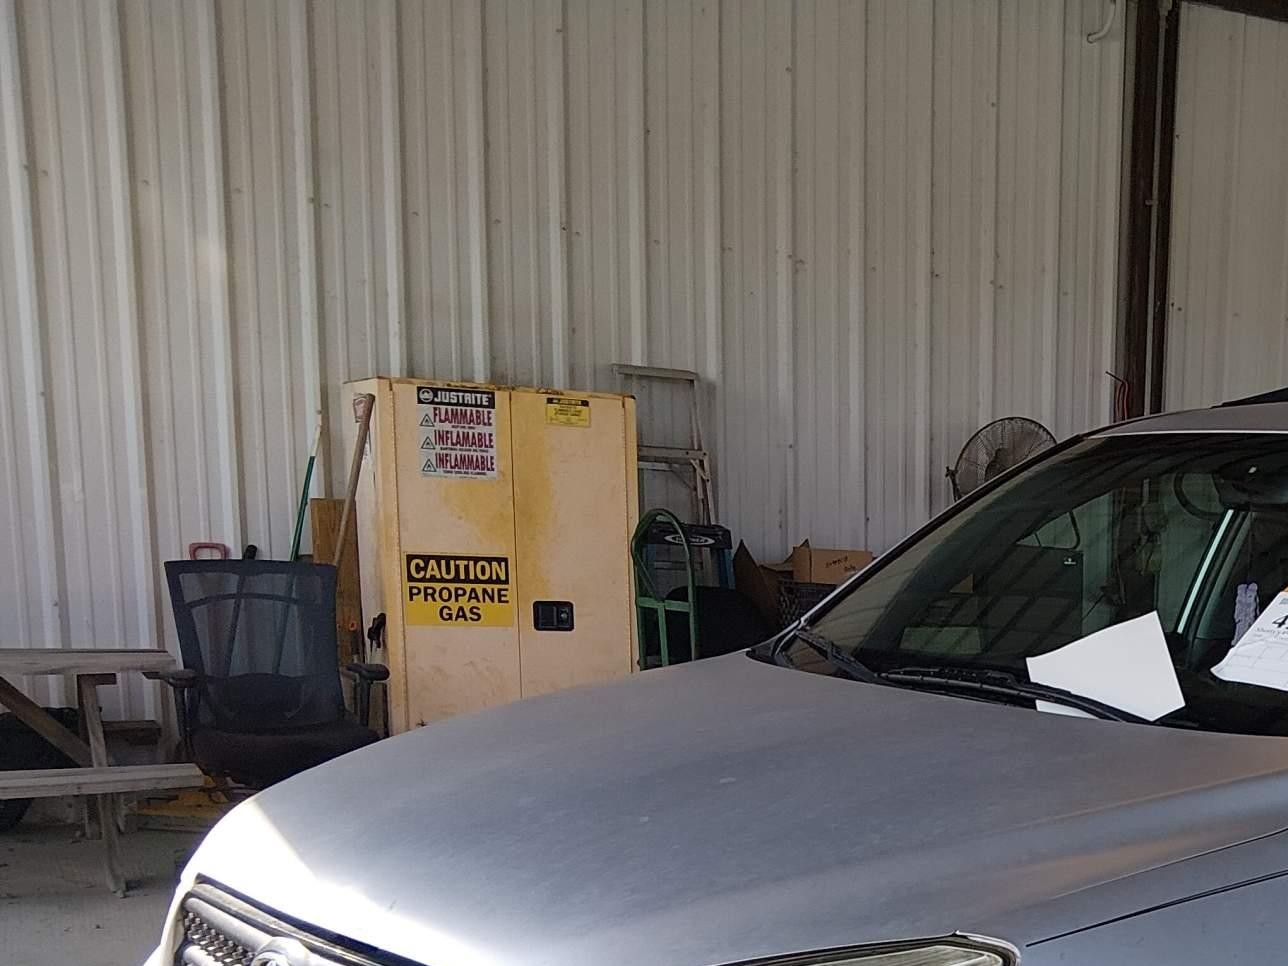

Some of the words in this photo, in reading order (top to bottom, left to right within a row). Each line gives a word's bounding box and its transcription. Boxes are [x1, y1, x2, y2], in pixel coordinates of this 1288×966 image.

[434, 391, 489, 406] JUSTRITE
[433, 407, 492, 426] FLAMMABLE
[434, 429, 494, 449] INFLAMABLE
[435, 452, 495, 472] INFLAMMABLE
[409, 557, 506, 581] CAUTION
[408, 585, 509, 604] PROPANE
[439, 605, 482, 622] GAS
